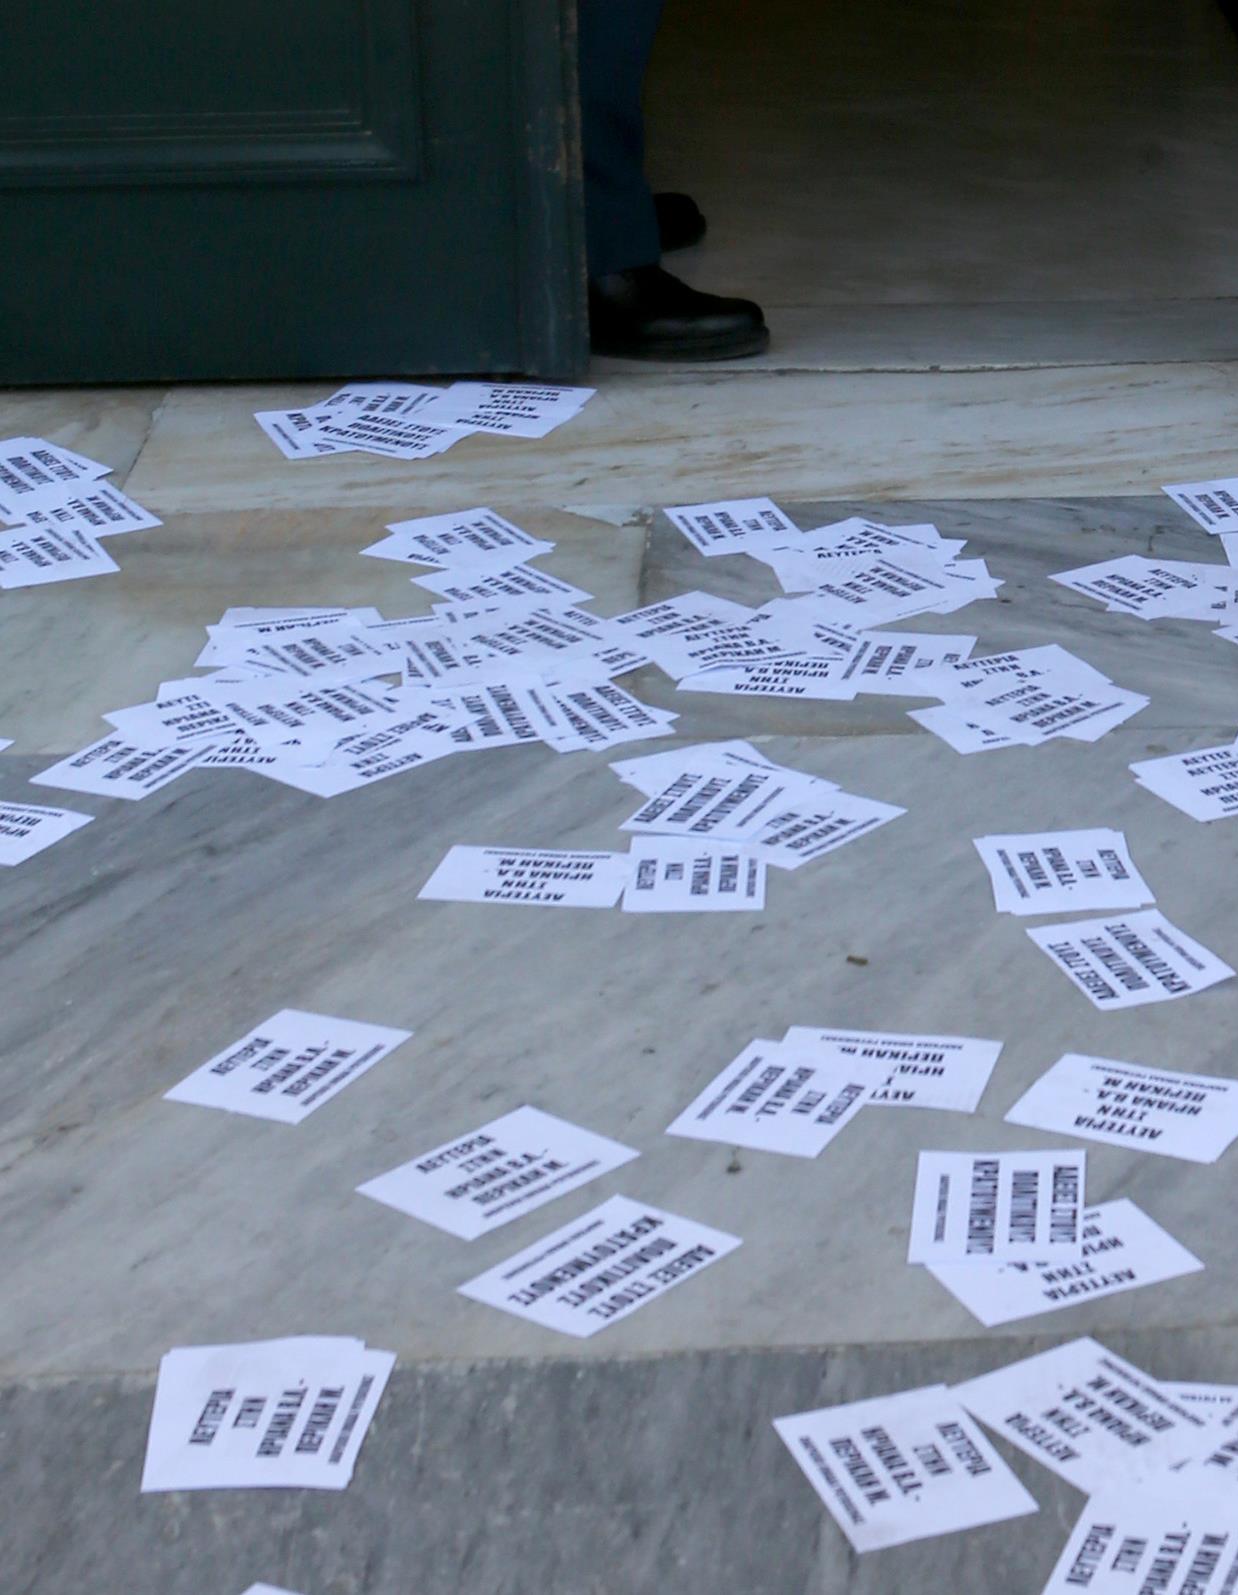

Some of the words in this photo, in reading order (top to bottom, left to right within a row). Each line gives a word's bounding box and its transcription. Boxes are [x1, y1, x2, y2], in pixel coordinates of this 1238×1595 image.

[519, 859, 594, 870] ΠΕΡΙΚΛΗ
[529, 870, 593, 880] ΗΡΙΑΝΑ
[502, 880, 546, 889] ΣΤΗΝ
[484, 890, 564, 901] ΛΕΥΤΕΡΙΑ
[1124, 1081, 1206, 1102] ΠΕΡΙΚΛΗ
[1097, 1104, 1147, 1121] ΣΤΗΝ
[1132, 1096, 1202, 1116] ΗΡΙΑΝΑ
[1074, 1116, 1163, 1139] ΛΕΥΤΕΡΙΑ
